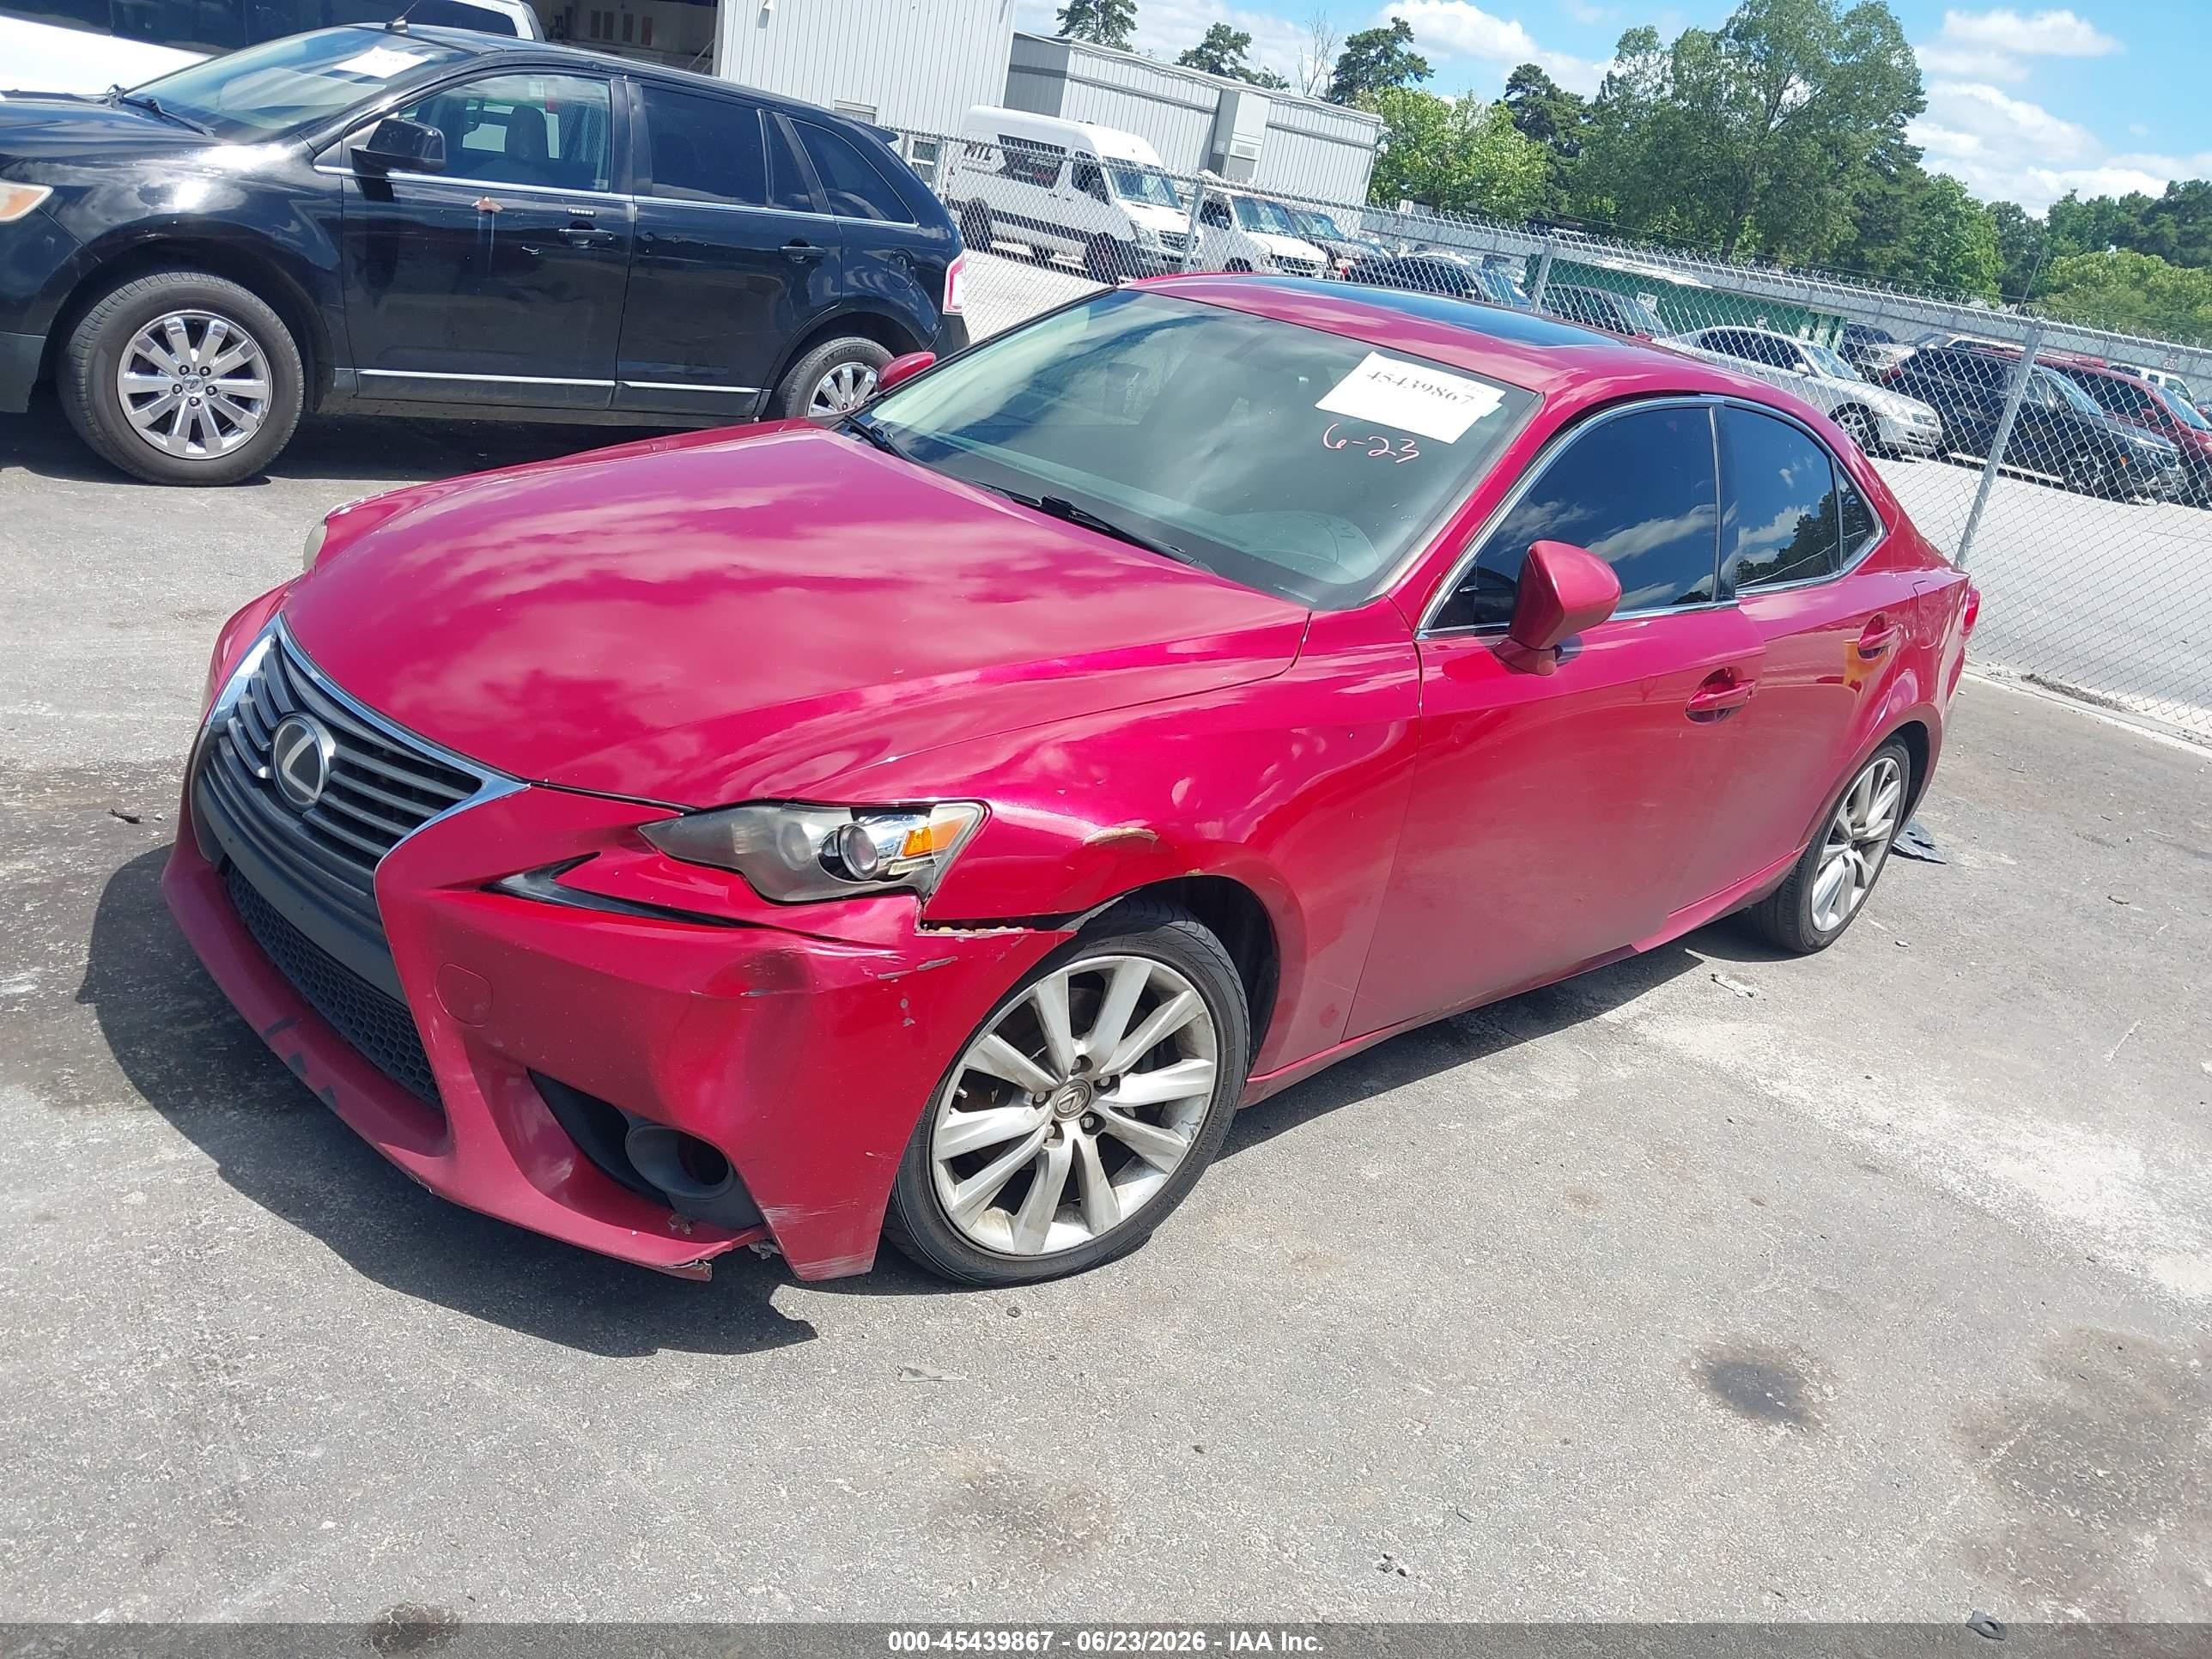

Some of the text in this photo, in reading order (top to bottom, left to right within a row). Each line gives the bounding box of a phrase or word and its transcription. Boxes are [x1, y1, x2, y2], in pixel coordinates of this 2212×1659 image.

[2164, 359, 2176, 369] 30
[1366, 371, 1474, 404] 45439867
[1322, 423, 1420, 463] 6-23
